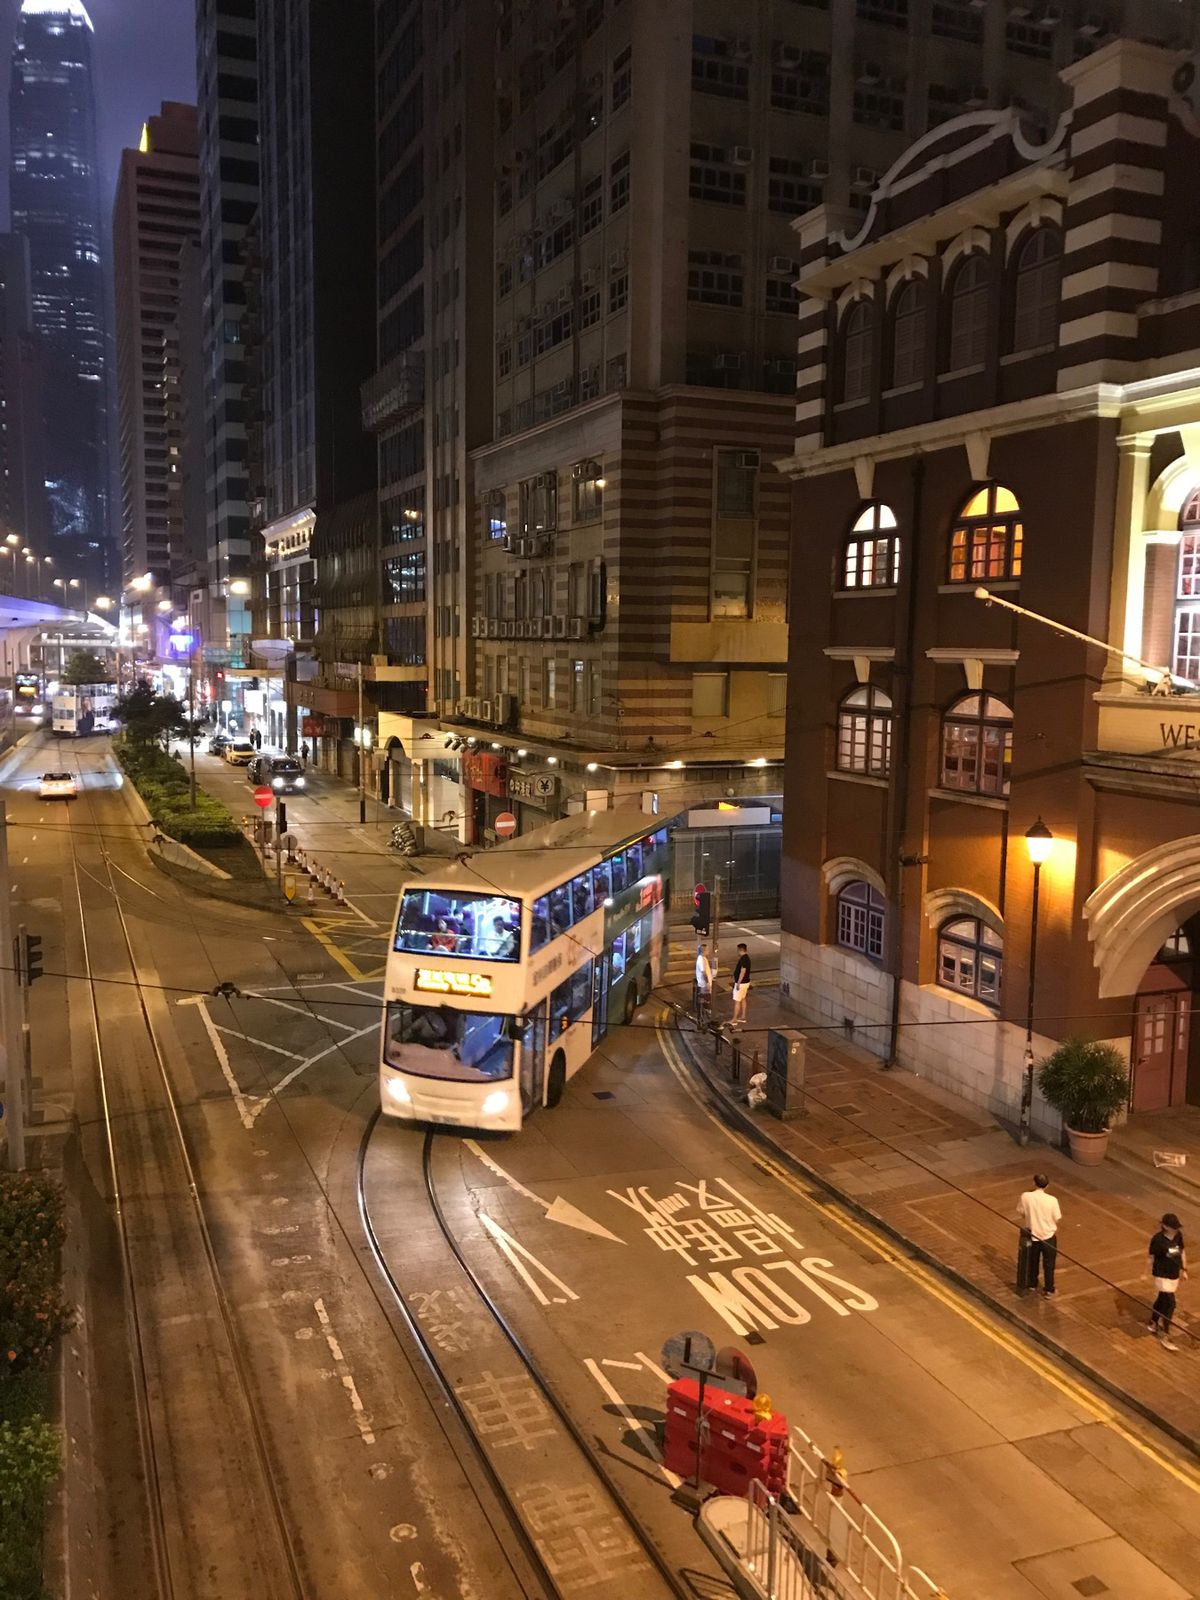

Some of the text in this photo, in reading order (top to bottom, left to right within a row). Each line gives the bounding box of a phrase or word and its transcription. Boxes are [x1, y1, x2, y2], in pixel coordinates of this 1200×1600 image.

[1159, 722, 1200, 751] WE
[604, 1176, 805, 1267] 慢駛
[685, 1256, 880, 1337] SLOW
